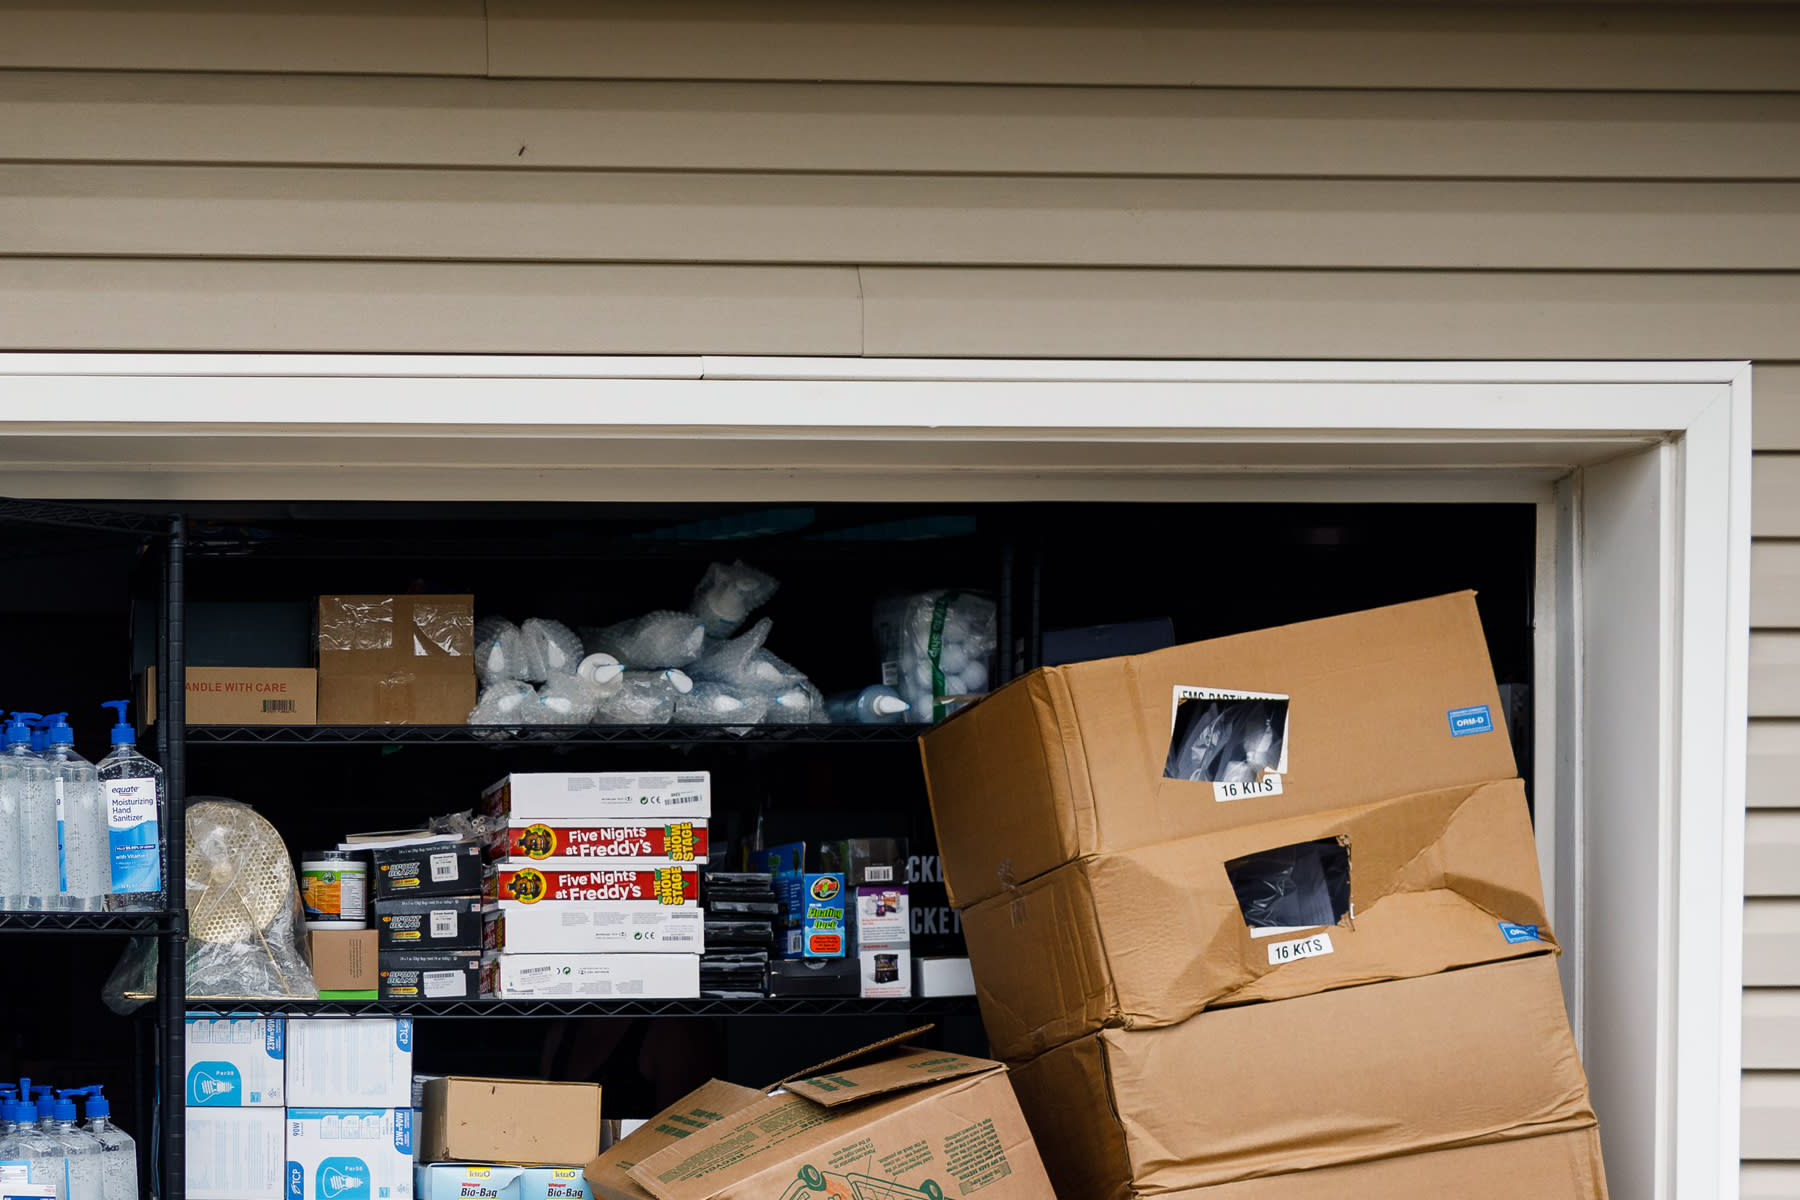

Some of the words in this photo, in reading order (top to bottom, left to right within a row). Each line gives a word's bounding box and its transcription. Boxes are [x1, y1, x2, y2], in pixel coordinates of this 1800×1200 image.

[927, 634, 942, 657] ship
[225, 682, 253, 692] WITH
[255, 682, 287, 693] CARE
[1456, 716, 1485, 727] ORM-D
[111, 785, 139, 794] equate
[1221, 783, 1238, 797] 16
[111, 798, 154, 806] Moisturizing
[112, 806, 132, 814] Hand
[112, 814, 143, 822] Sanitizer
[568, 830, 598, 844] Five
[600, 827, 647, 841] Nights
[671, 823, 683, 861] SHOW
[681, 821, 694, 862] STAGE
[565, 846, 578, 856] at
[580, 839, 652, 857] Freddy's
[664, 839, 672, 853] THE
[389, 862, 421, 871] SPORT
[558, 874, 588, 888] Five
[590, 870, 637, 886] Nights
[671, 865, 684, 906] STAGE
[555, 890, 568, 900] at
[569, 883, 642, 901] Freddy's
[653, 883, 661, 896] THE
[660, 867, 673, 905] SHOW
[391, 915, 422, 924] SPORT
[808, 907, 843, 920] Floating
[813, 919, 838, 930] Dock
[1274, 945, 1290, 960] 16
[1293, 938, 1323, 956] KITS
[389, 971, 419, 979] SPORT
[399, 1028, 409, 1045] TCP
[291, 1121, 300, 1137] 90W
[291, 1168, 300, 1185] TCP
[469, 1169, 486, 1178] Tetra
[554, 1170, 571, 1178] Tetra
[460, 1188, 498, 1199] Bio-Bag
[547, 1188, 584, 1199] Bio-Bag
